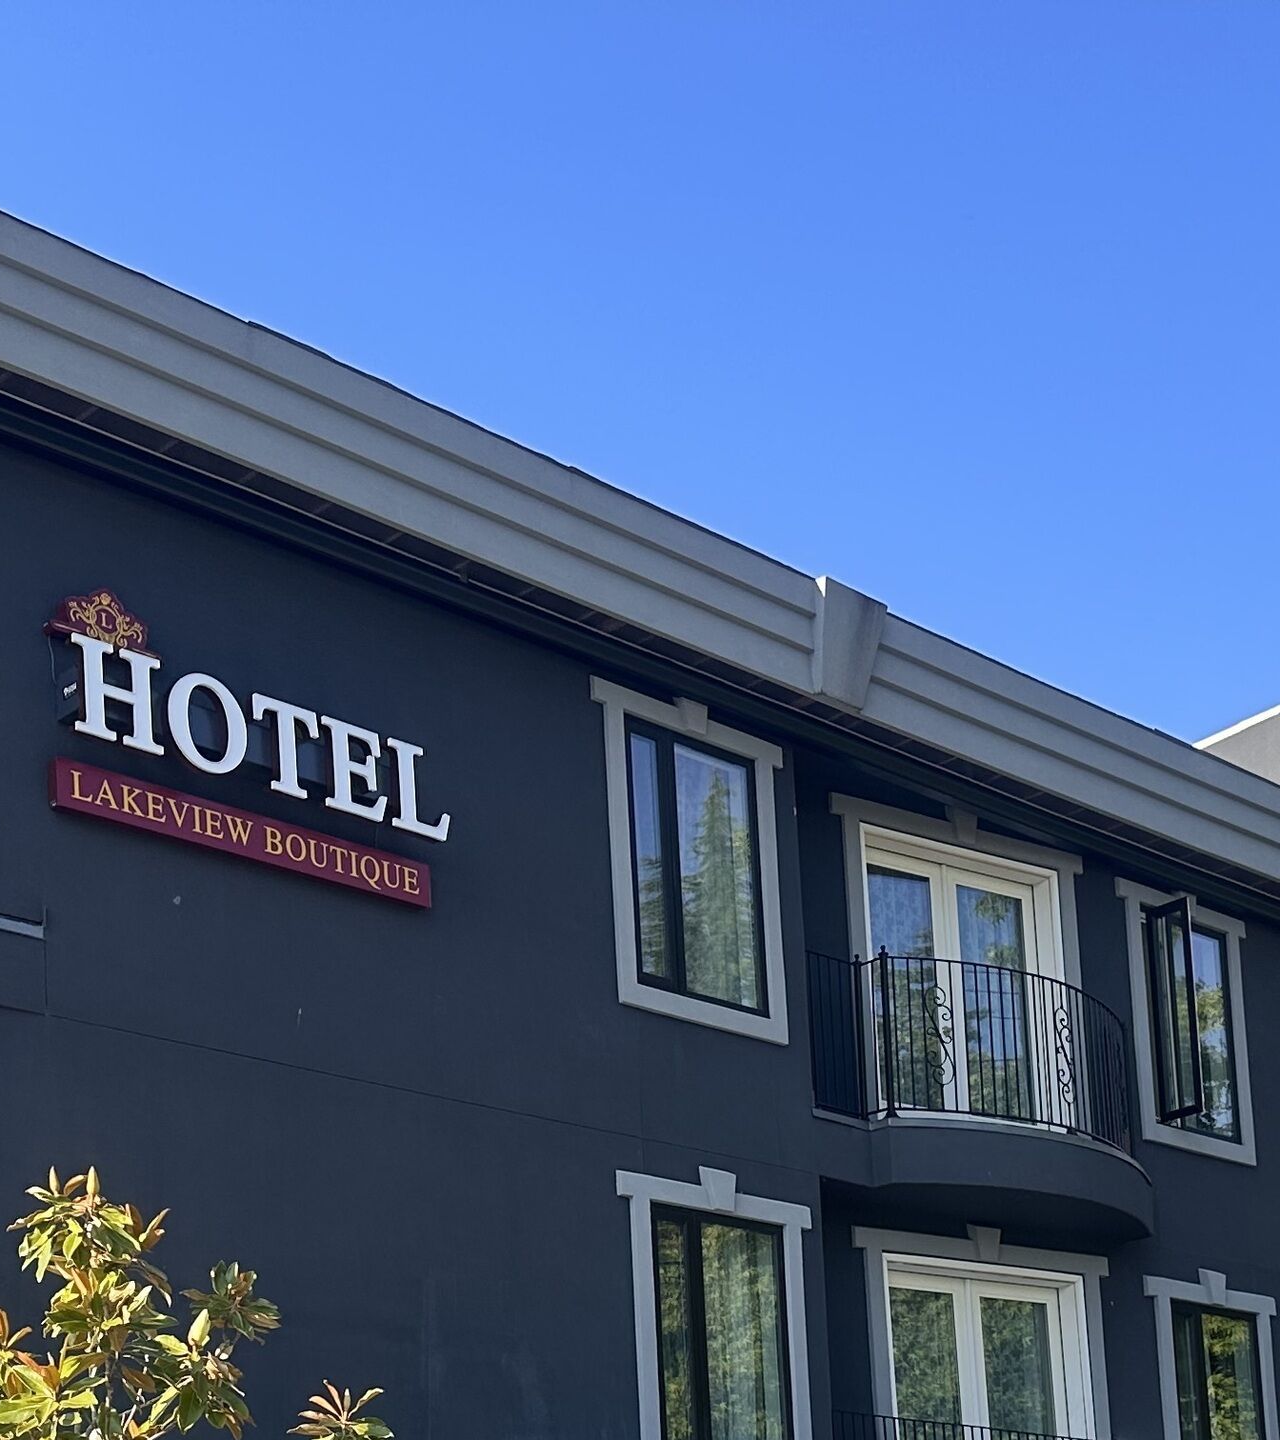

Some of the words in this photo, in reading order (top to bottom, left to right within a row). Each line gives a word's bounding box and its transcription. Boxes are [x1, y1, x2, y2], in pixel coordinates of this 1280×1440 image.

[100, 612, 113, 629] L
[70, 632, 451, 842] HOTEL
[70, 770, 253, 846] LAKEVIEW
[264, 826, 420, 895] BOUTIQUE
